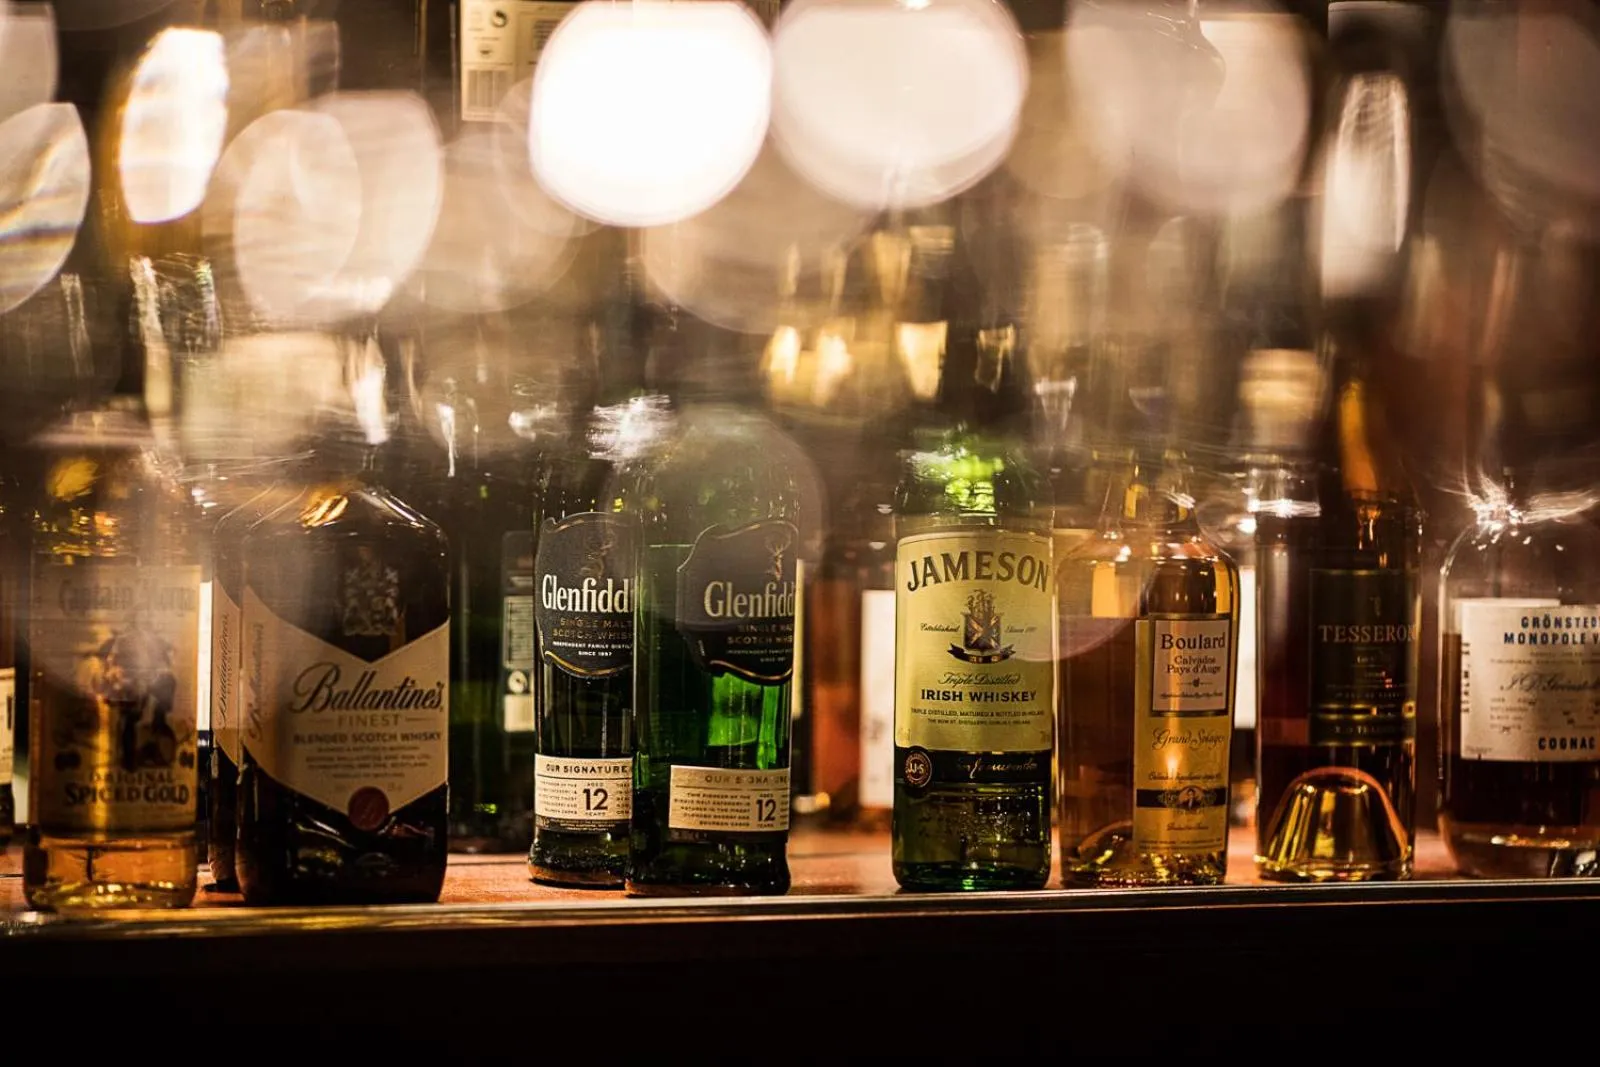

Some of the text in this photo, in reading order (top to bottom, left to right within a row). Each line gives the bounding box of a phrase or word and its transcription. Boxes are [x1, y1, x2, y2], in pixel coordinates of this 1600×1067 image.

[907, 551, 1049, 592] JAMESON
[1521, 614, 1600, 628] GRÖNSTED
[1161, 632, 1226, 649] Boulard
[1504, 632, 1586, 645] MONOPOLE
[288, 661, 444, 714] Ballantine's
[921, 689, 1037, 703] IRISH WHISKEY
[337, 714, 401, 727] FINEST
[293, 732, 441, 744] BLENDED SCOTCH WHISKY
[1151, 728, 1193, 751] Grand
[1538, 736, 1596, 750] COGNAC
[546, 763, 628, 774] OUR SIGNATURE
[582, 787, 609, 811] 12
[755, 798, 777, 822] 12
